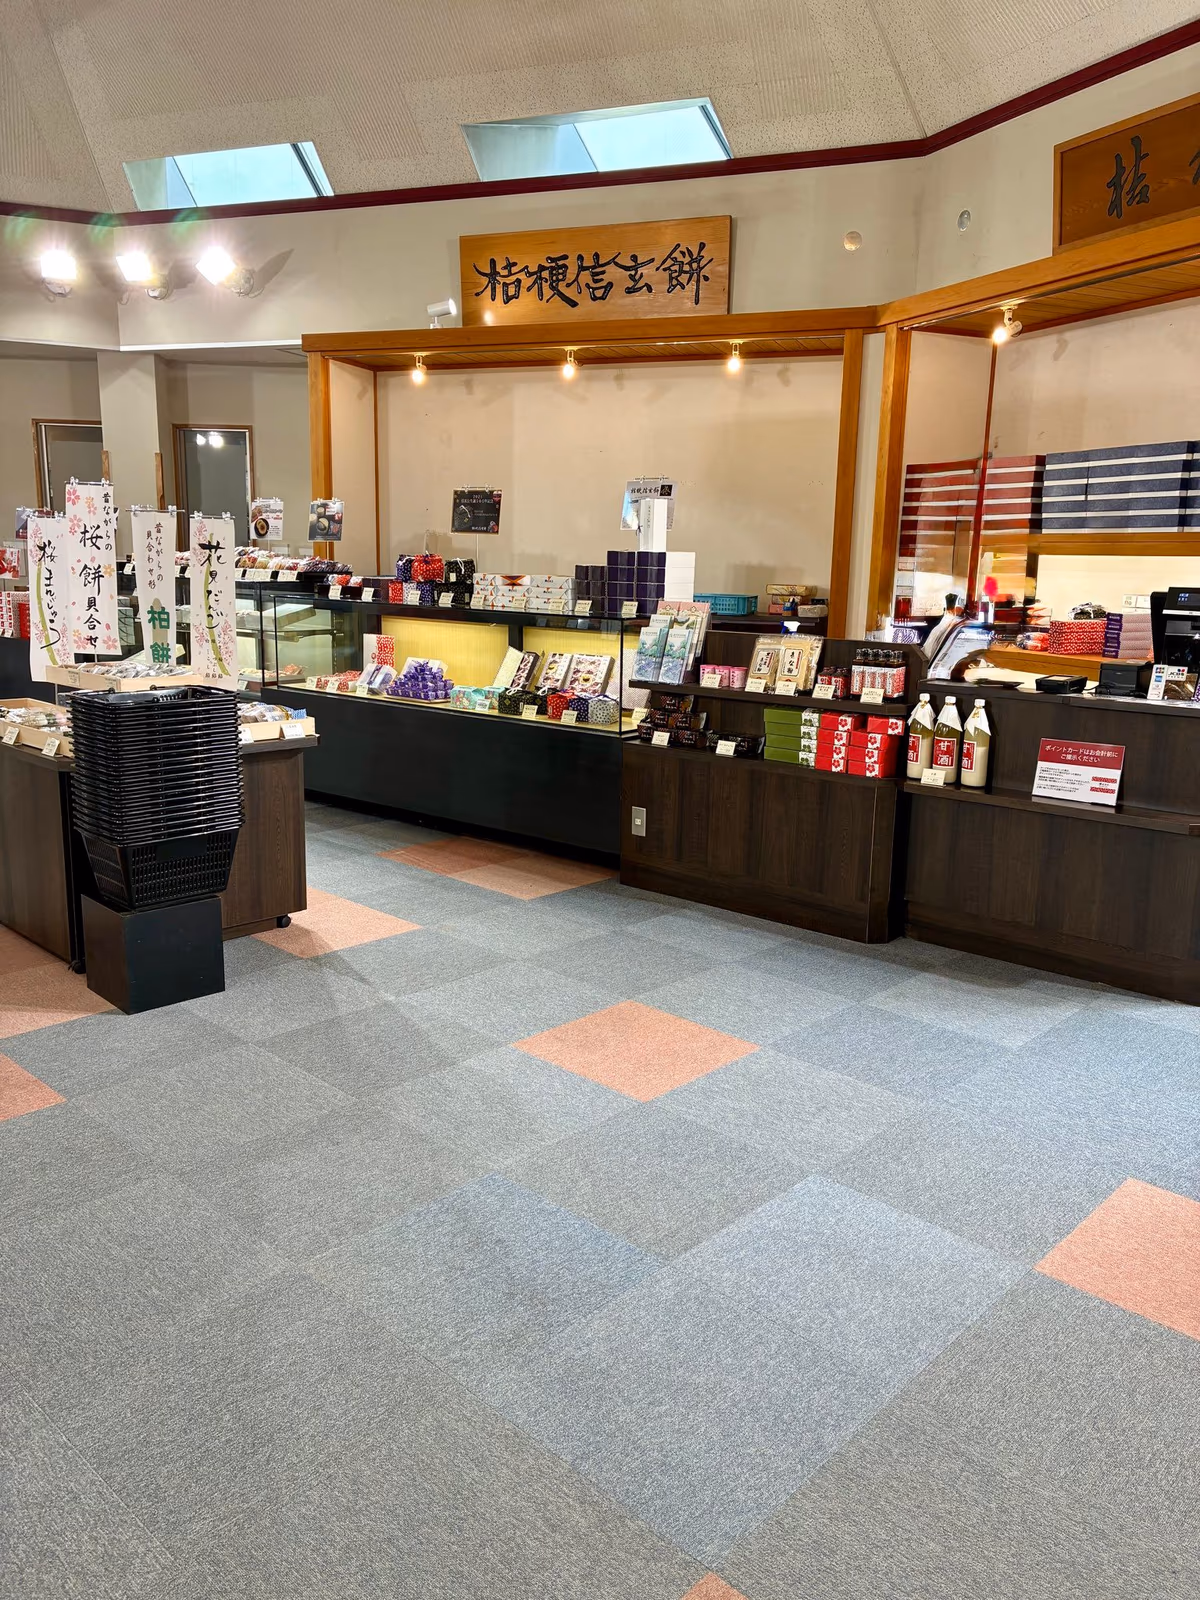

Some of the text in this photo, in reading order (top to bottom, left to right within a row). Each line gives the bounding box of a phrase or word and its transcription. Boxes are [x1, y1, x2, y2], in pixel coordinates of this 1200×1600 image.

[472, 241, 714, 308] 桔梗信玄餅
[102, 492, 113, 551] 昔ながらの
[154, 522, 163, 582] 昔ながらの
[36, 540, 61, 649] 桜まんじゅう
[79, 523, 105, 648] 桜餅貝合せ
[198, 540, 228, 630] 花見だんご
[147, 604, 172, 663] 柏餅
[937, 740, 952, 766] 甘酒
